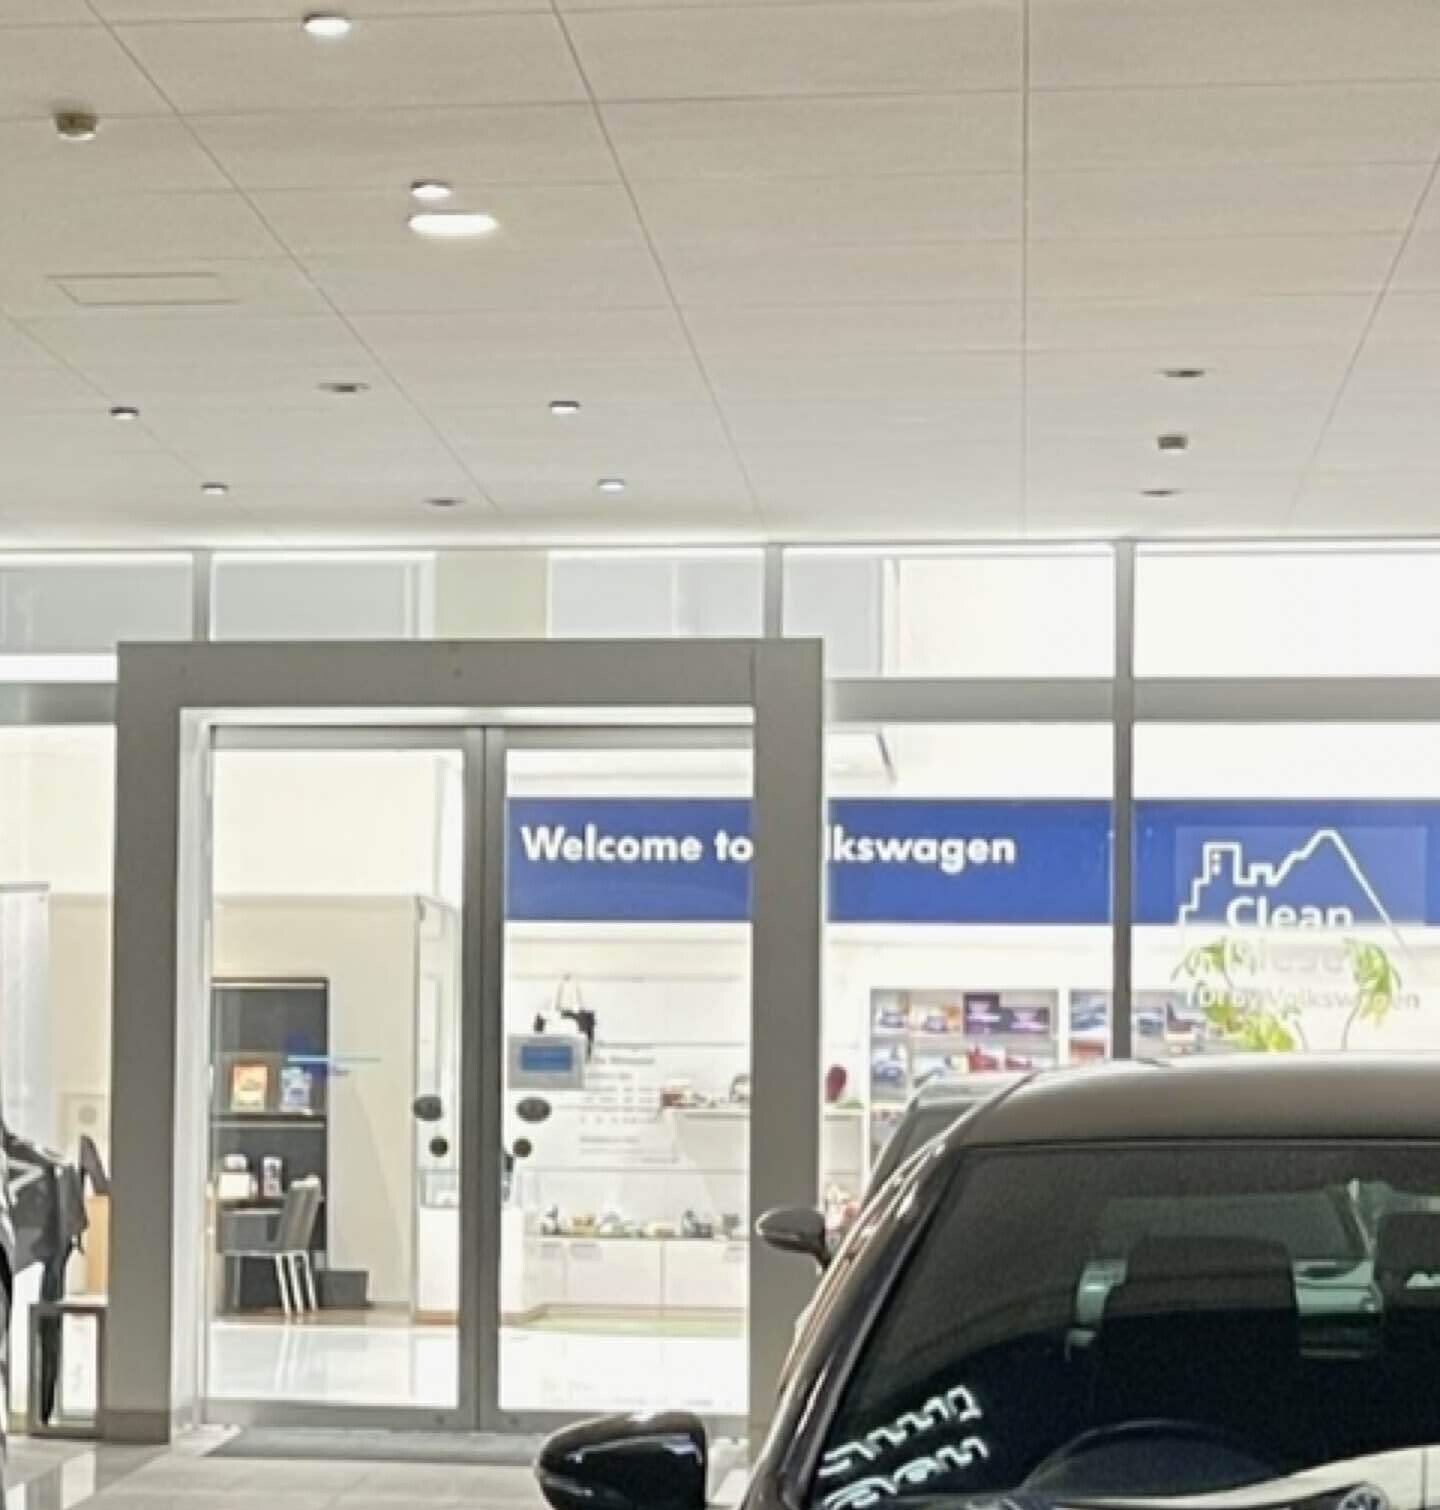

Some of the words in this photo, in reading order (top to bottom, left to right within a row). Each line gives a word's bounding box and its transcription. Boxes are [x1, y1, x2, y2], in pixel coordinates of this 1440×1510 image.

[520, 823, 702, 862] Welcome
[714, 829, 754, 862] to
[823, 823, 1016, 874] lkswagen
[1226, 895, 1354, 929] Clean
